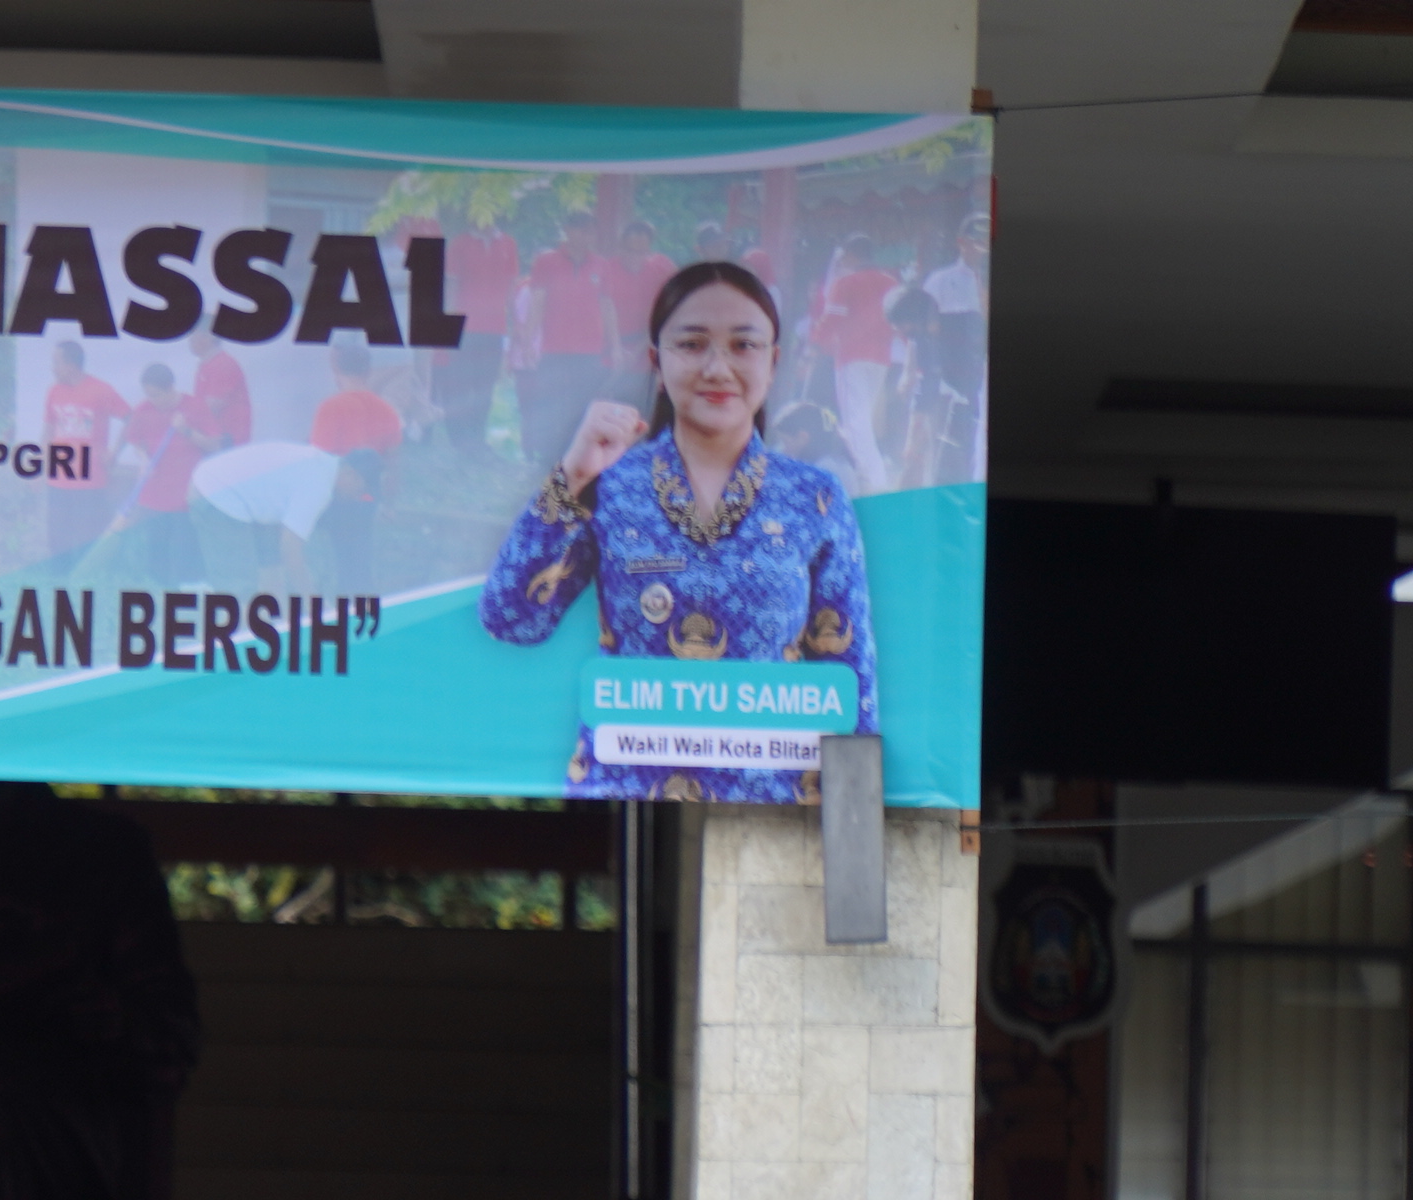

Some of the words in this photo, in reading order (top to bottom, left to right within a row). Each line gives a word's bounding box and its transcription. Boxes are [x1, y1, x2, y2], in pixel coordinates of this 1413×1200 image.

[594, 678, 663, 712] ELIM
[670, 681, 729, 714] TYU
[736, 683, 843, 717] SAMBA
[617, 735, 668, 755] Wakil
[673, 737, 713, 757] Wali
[719, 738, 763, 759] Kota
[770, 740, 820, 761] Blitar
